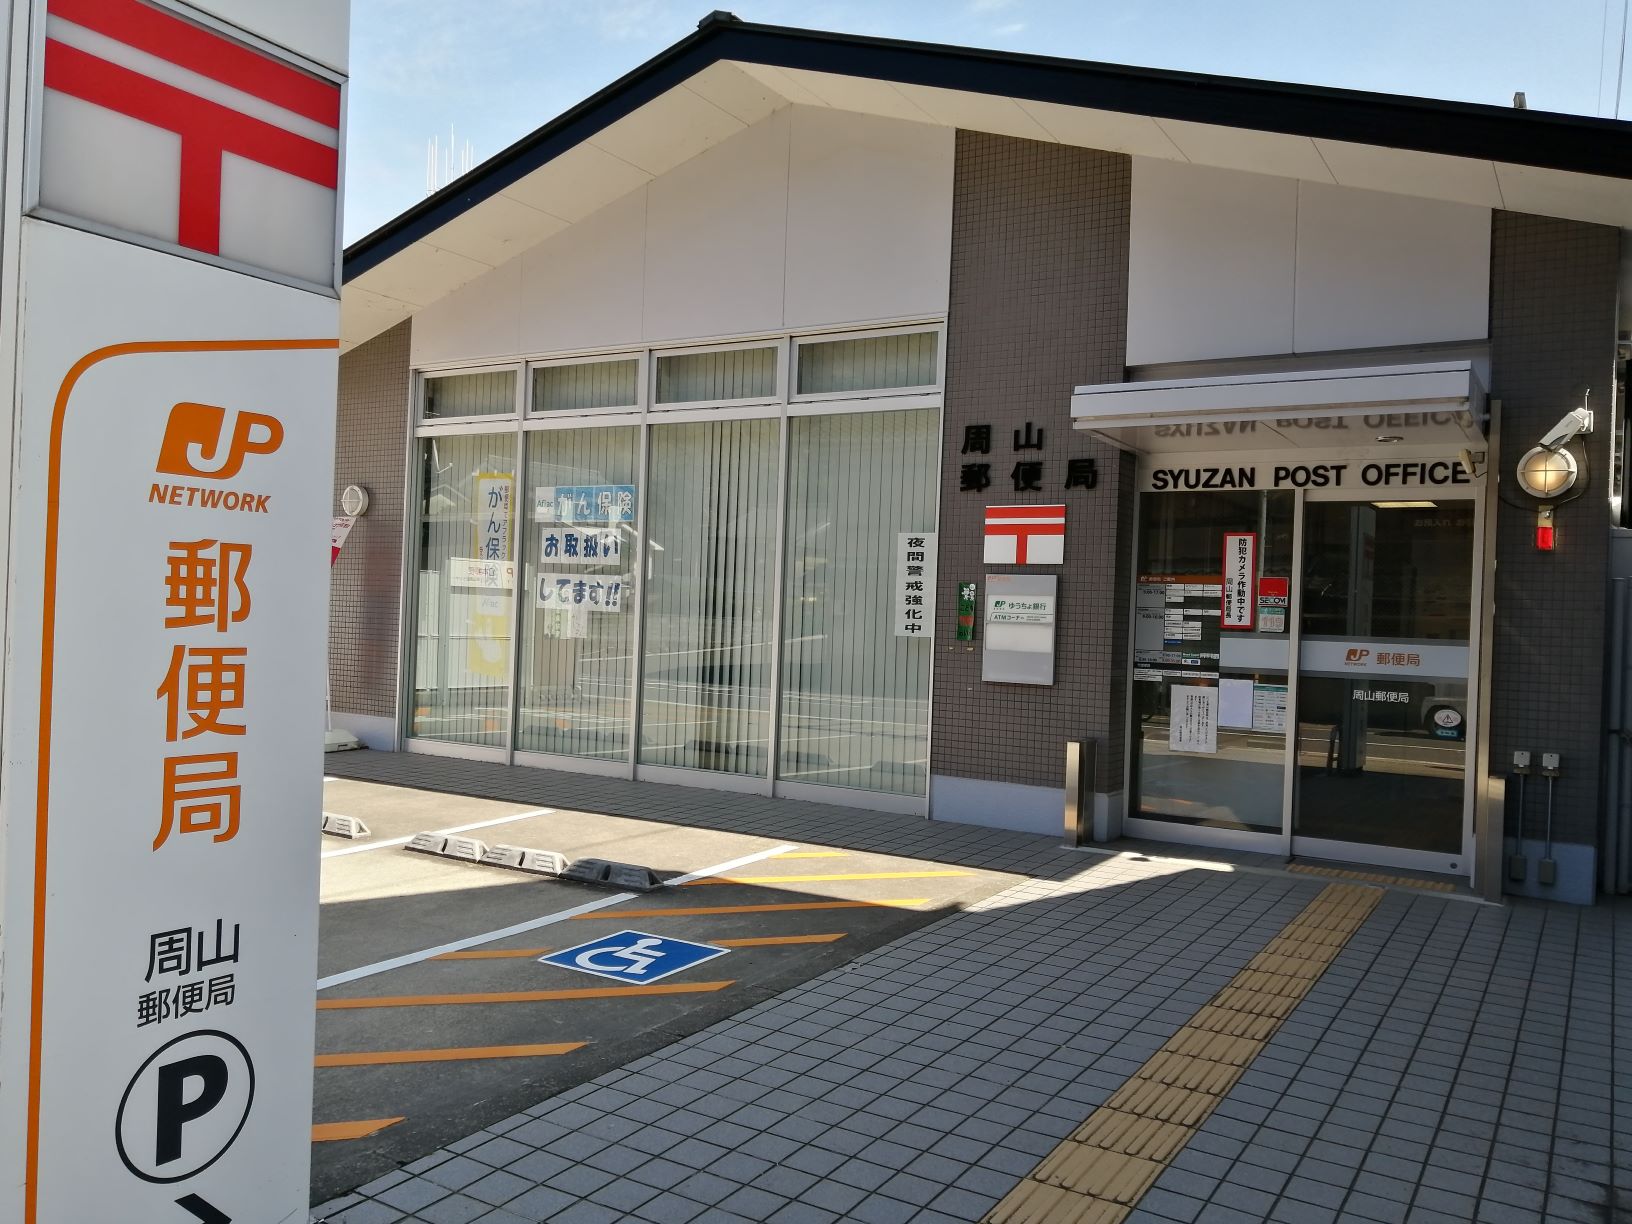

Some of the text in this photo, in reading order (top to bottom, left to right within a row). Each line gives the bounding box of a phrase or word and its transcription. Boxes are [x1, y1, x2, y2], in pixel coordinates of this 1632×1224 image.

[156, 402, 284, 480] JP
[961, 422, 1043, 454] 周山
[960, 458, 1098, 492] 郵便局
[1151, 460, 1471, 491] SYUZAN POST OFFICE
[148, 483, 271, 513] NETWORK
[537, 499, 554, 508] Aflac
[557, 491, 632, 516] がん保険
[544, 533, 619, 558] お取扱い
[904, 537, 926, 634] 夜間警戒強化中
[1237, 537, 1248, 623] 防犯カメラ作動中です
[1008, 602, 1047, 611] ゆうちょ銀行
[1259, 597, 1286, 605] SECOM
[1376, 652, 1420, 667] 郵便局
[152, 538, 253, 853] 郵便局
[1352, 689, 1410, 704] 周山郵便局
[144, 918, 240, 983] 周山
[137, 973, 236, 1029] 郵便局
[156, 1053, 229, 1167] P
